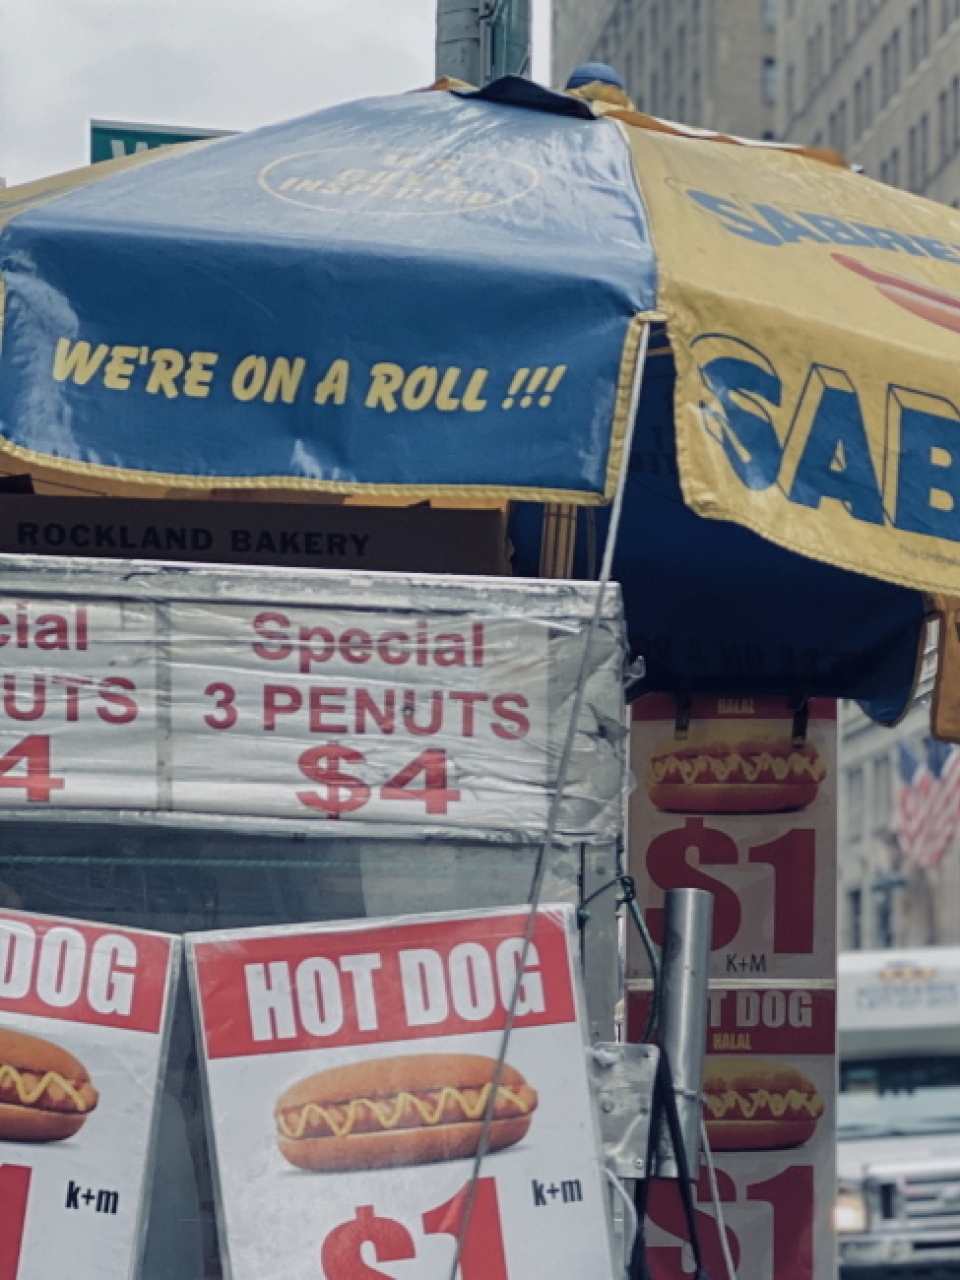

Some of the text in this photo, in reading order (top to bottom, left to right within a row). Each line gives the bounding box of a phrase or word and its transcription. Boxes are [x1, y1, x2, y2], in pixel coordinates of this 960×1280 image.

[52, 337, 566, 413] WE'RE ON A ROLL !!!
[17, 523, 371, 557] ROCKLAND BAKERY
[252, 611, 485, 674] Special
[203, 682, 531, 740] 3 PENUTS
[296, 741, 461, 819] $4
[645, 818, 816, 954] $1
[726, 953, 768, 973] K+M
[244, 936, 546, 1042] HOT DOG
[736, 989, 812, 1028] DOG
[713, 1033, 752, 1051] HALAL
[65, 1180, 119, 1215] k+m
[532, 1178, 583, 1206] k+m
